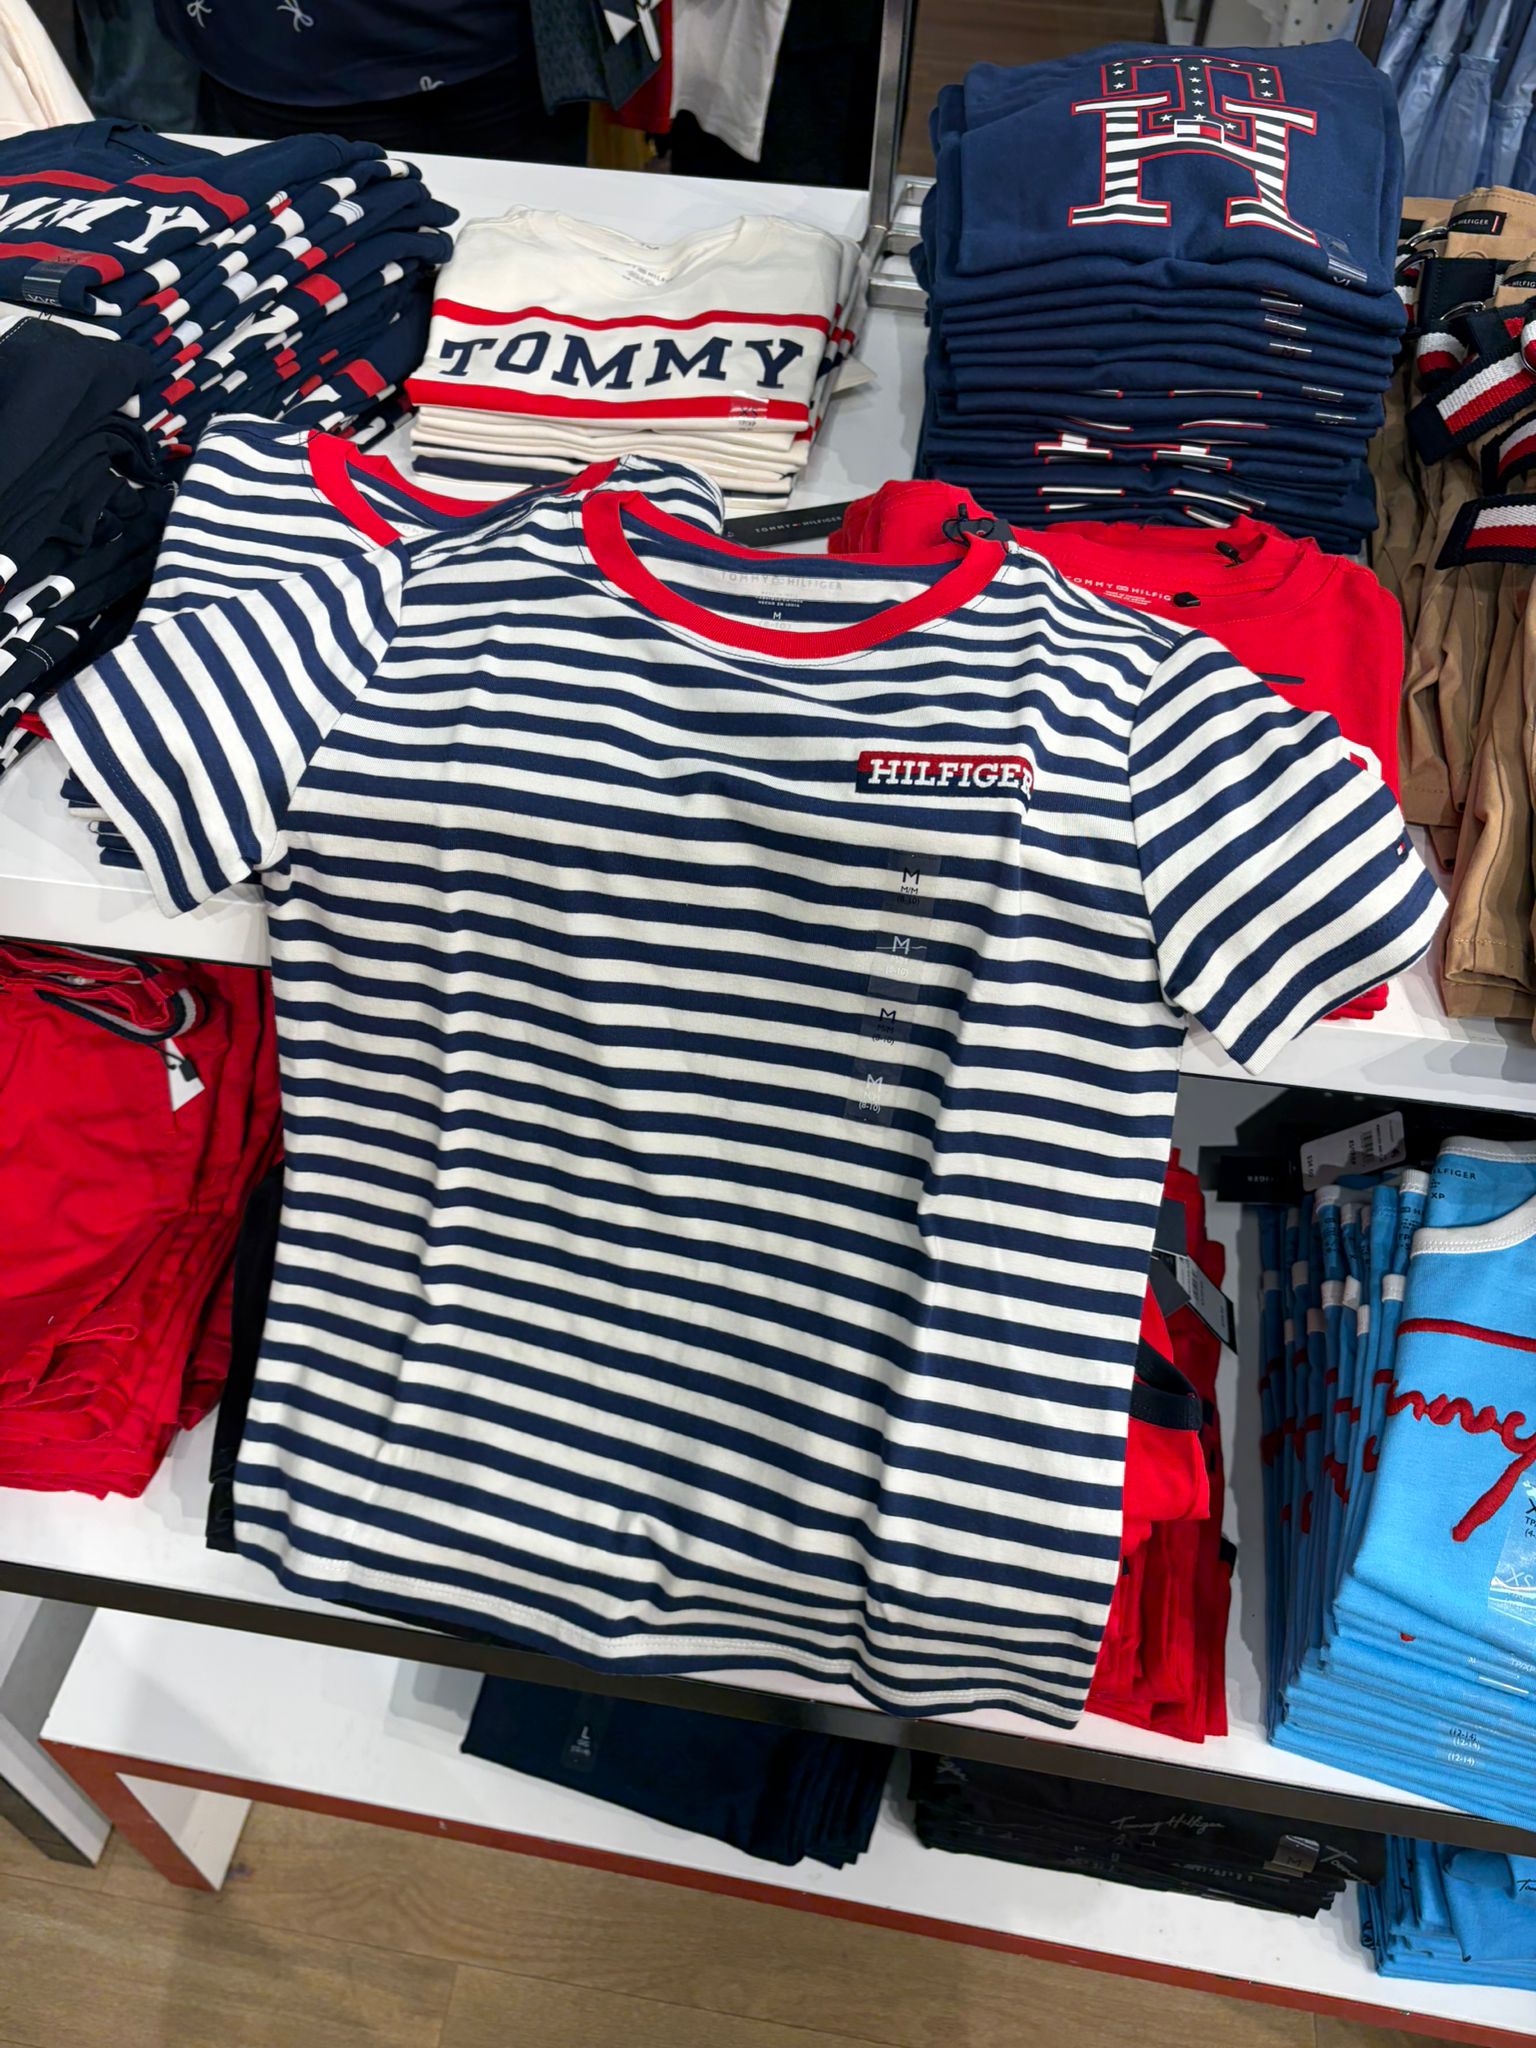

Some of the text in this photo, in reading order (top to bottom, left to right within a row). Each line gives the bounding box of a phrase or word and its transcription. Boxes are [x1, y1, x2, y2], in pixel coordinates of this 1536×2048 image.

[439, 331, 803, 390] TOMMY
[755, 515, 843, 534] TOMMY HILFIGER
[772, 611, 782, 620] M
[868, 758, 1033, 801] HILFIGER
[902, 866, 920, 885] M
[892, 935, 911, 955] M
[880, 1007, 897, 1024] M
[1447, 1753, 1475, 1767] (12-14)
